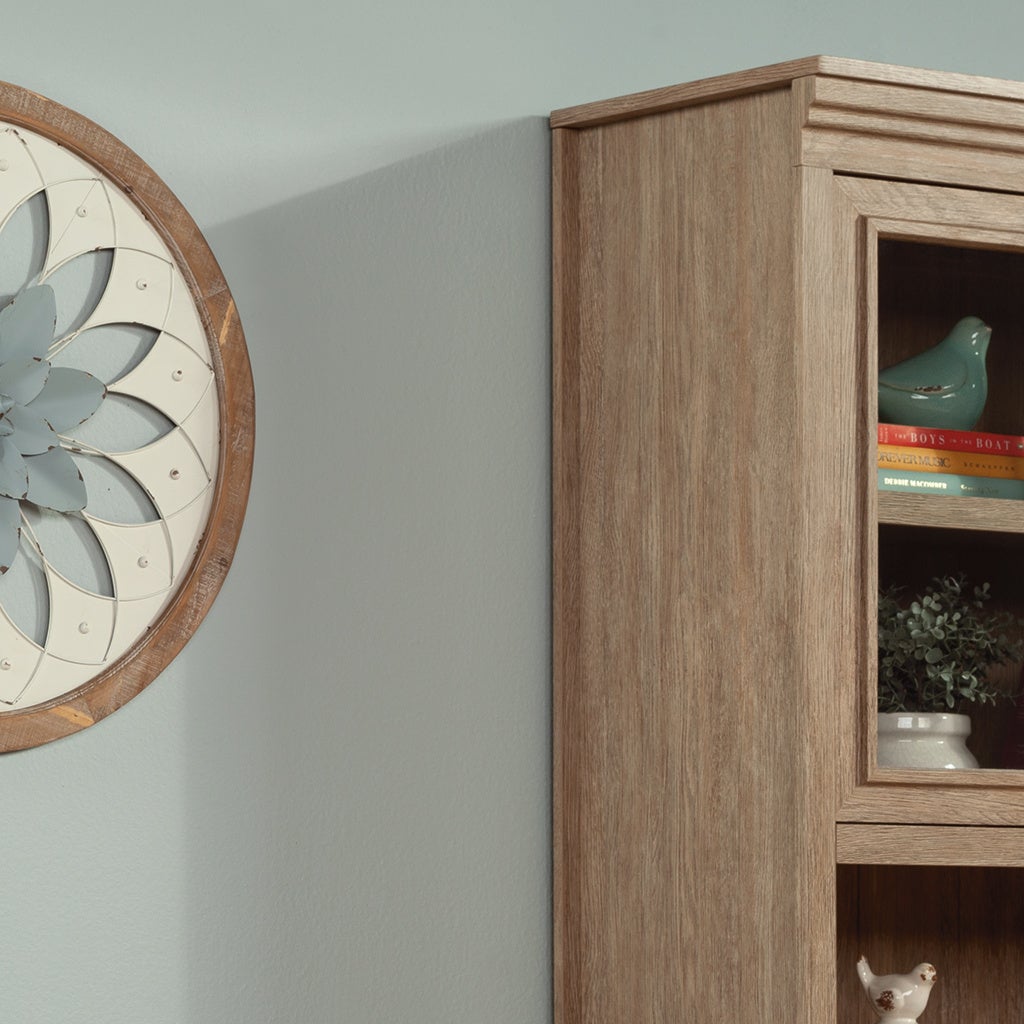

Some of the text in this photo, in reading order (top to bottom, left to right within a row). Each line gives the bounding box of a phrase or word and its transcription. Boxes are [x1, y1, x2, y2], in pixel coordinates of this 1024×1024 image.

[911, 432, 945, 445] BOYS
[977, 438, 1011, 450] BOAT
[917, 455, 951, 468] MUSIC
[884, 477, 909, 487] DEBBIE
